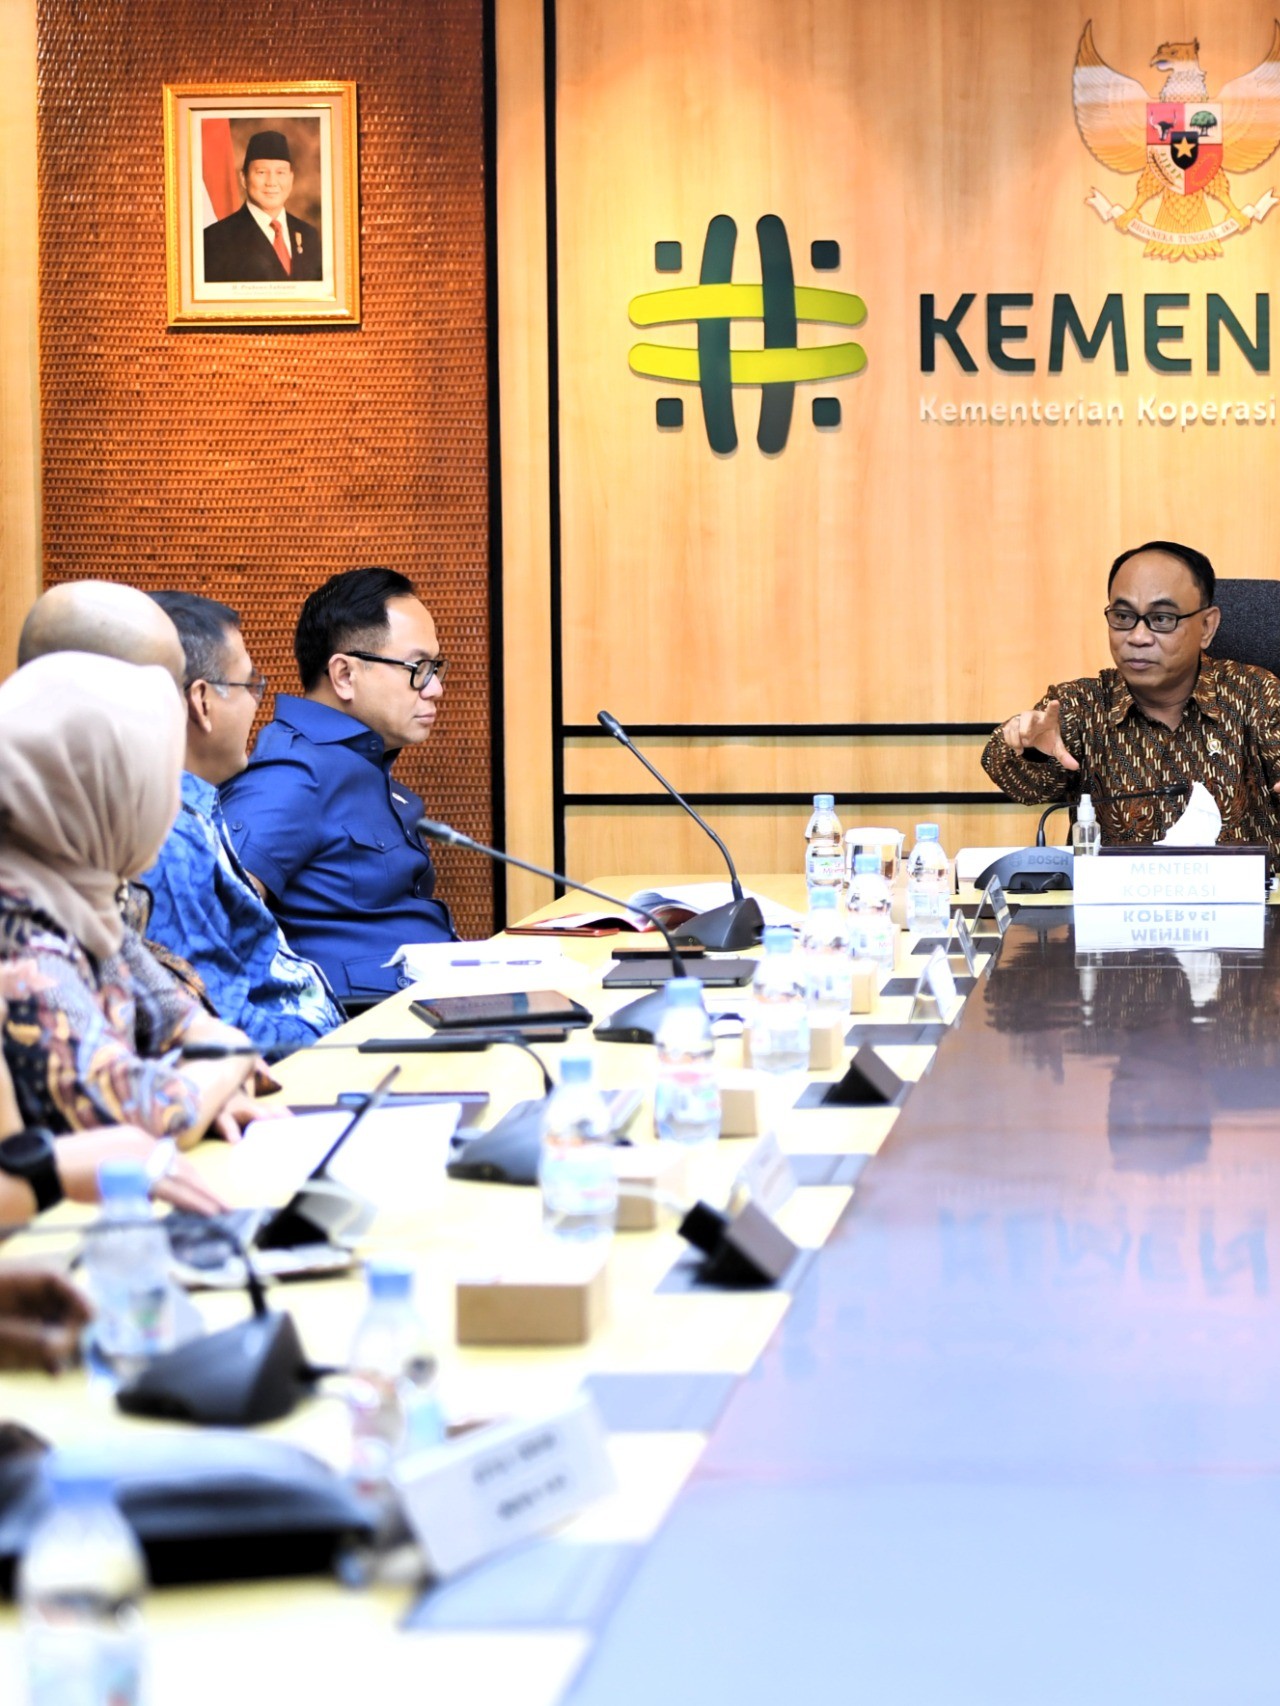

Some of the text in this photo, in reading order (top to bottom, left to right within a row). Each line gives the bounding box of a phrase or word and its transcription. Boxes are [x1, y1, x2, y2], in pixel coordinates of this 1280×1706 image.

[919, 394, 1125, 423] Kementerian
[1138, 393, 1276, 428] Koperasi
[1027, 854, 1069, 866] BOSCH
[1130, 862, 1209, 875] MENTERI
[1123, 884, 1216, 897] KOPERASI
